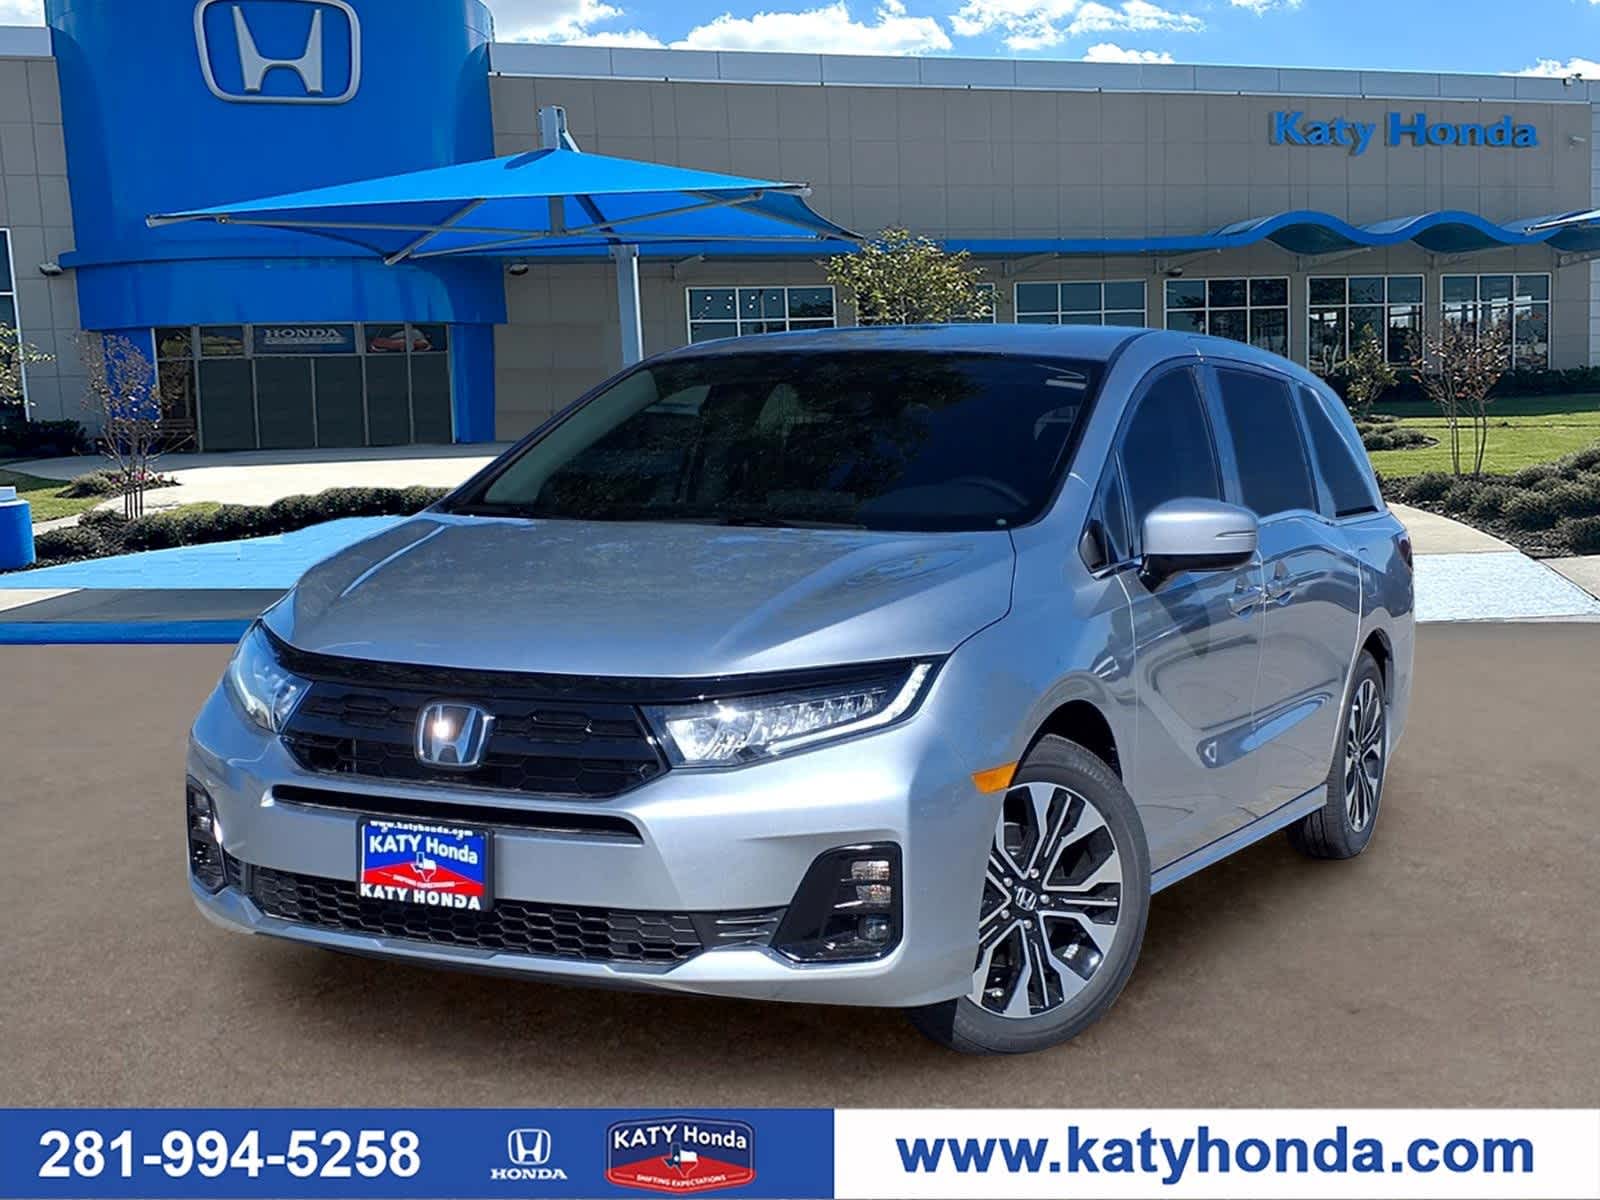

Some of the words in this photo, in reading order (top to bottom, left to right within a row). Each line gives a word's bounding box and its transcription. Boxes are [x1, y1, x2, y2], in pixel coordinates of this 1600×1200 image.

[1272, 111, 1376, 156] Katy
[1386, 111, 1538, 147] Honda
[263, 328, 342, 338] HONDA
[369, 834, 422, 854] KATY
[425, 836, 478, 865] Honda
[360, 883, 408, 902] KATY
[413, 889, 481, 911] HONDA
